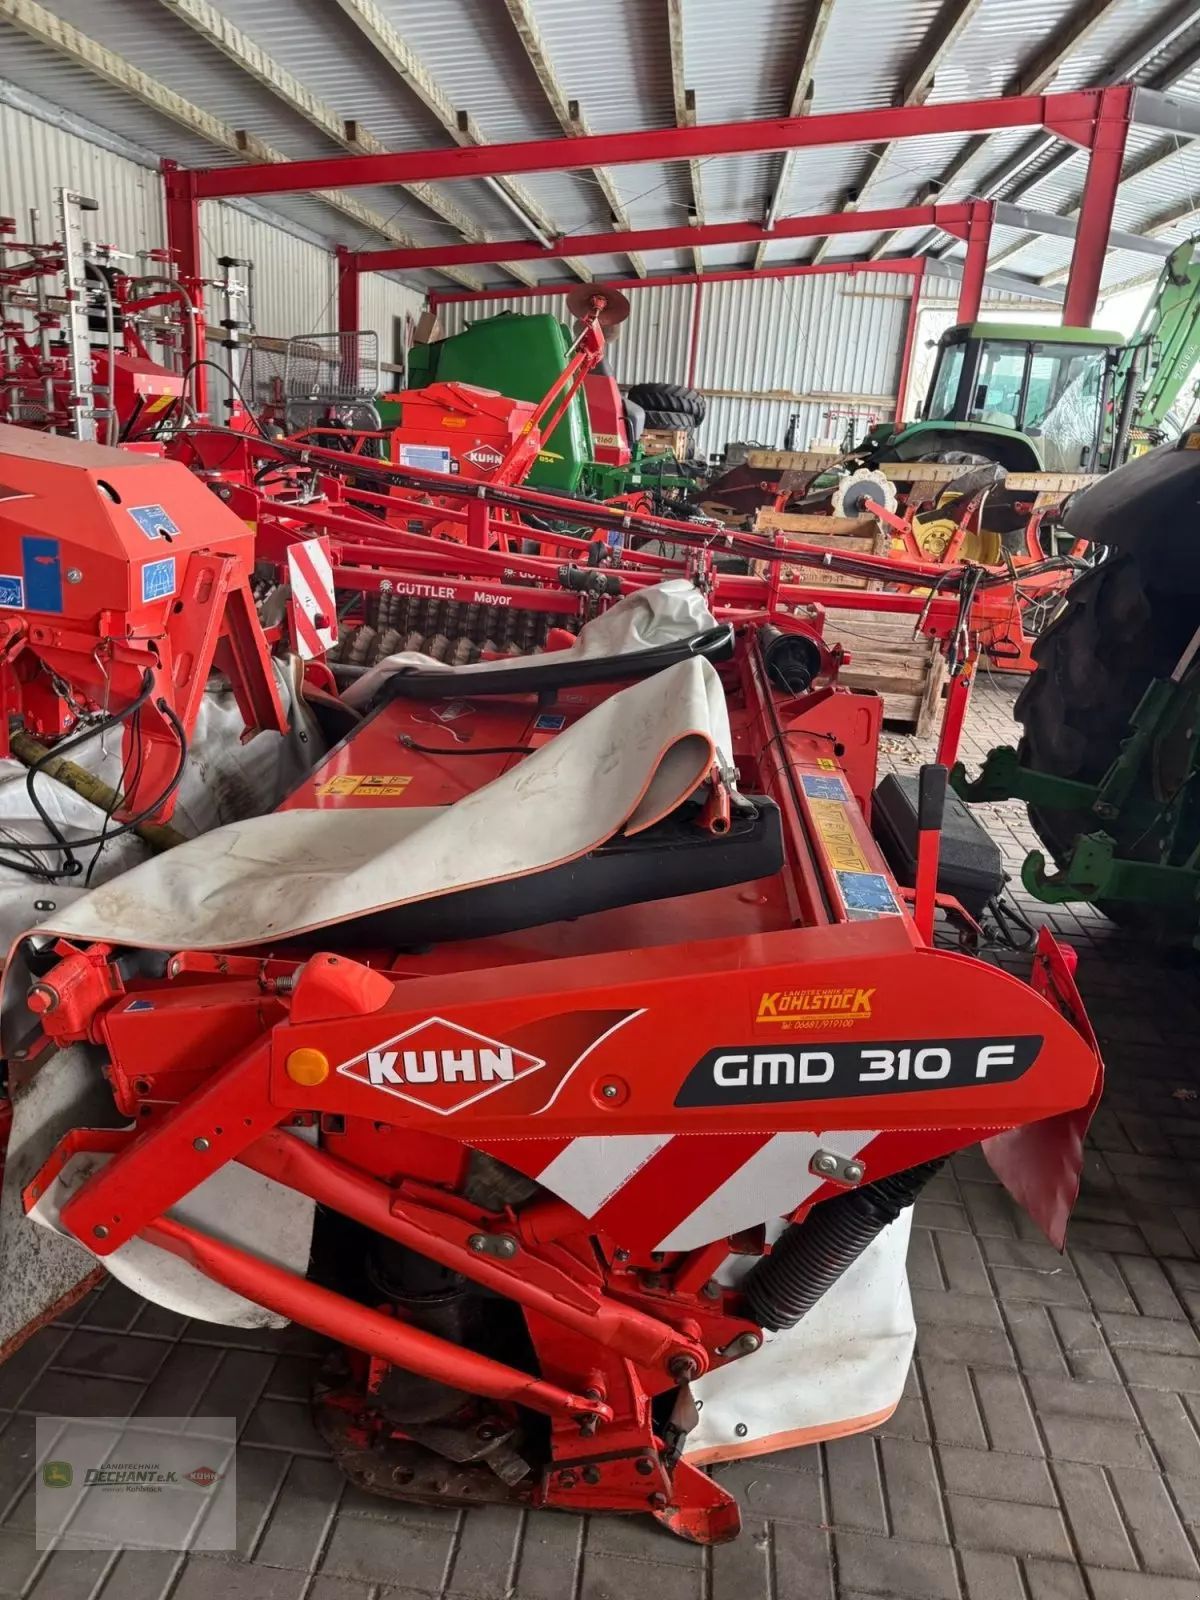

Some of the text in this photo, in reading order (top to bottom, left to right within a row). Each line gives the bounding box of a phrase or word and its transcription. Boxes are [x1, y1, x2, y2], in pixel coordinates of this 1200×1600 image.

[470, 452, 503, 464] KUHN
[474, 591, 512, 605] Mayor
[758, 988, 876, 1015] KOHLSTOCK
[783, 988, 841, 997] LANDTECHNIK
[367, 1048, 515, 1084] KUHN
[713, 1045, 1016, 1086] GMD 310 F
